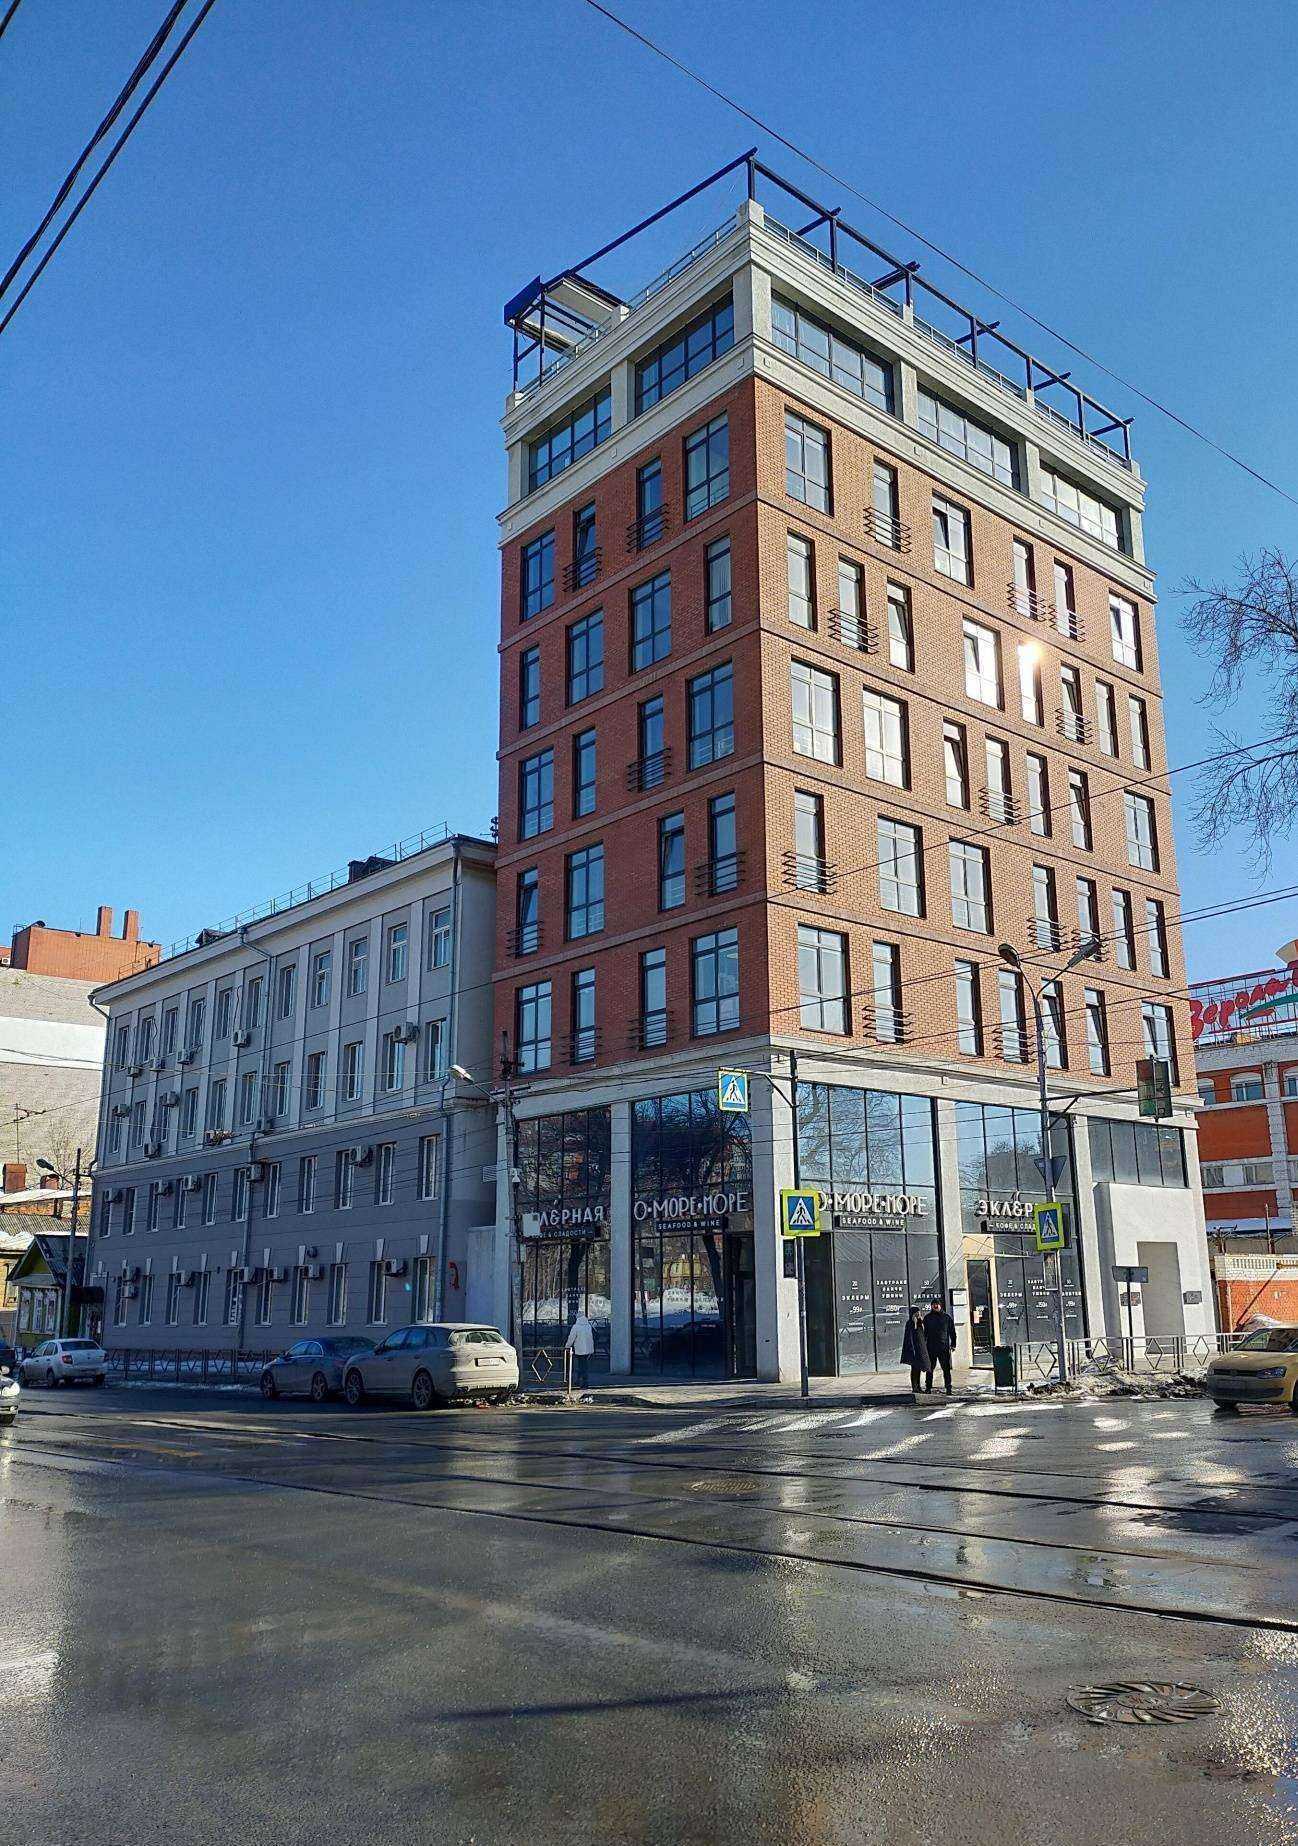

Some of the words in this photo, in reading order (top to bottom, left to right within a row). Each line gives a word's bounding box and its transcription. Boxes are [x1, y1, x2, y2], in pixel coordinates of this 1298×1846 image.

[658, 1221, 692, 1230] SEAFOOD
[700, 1219, 721, 1227] WINE
[842, 1217, 877, 1226] SEAFOOD
[885, 1218, 906, 1227] WINE
